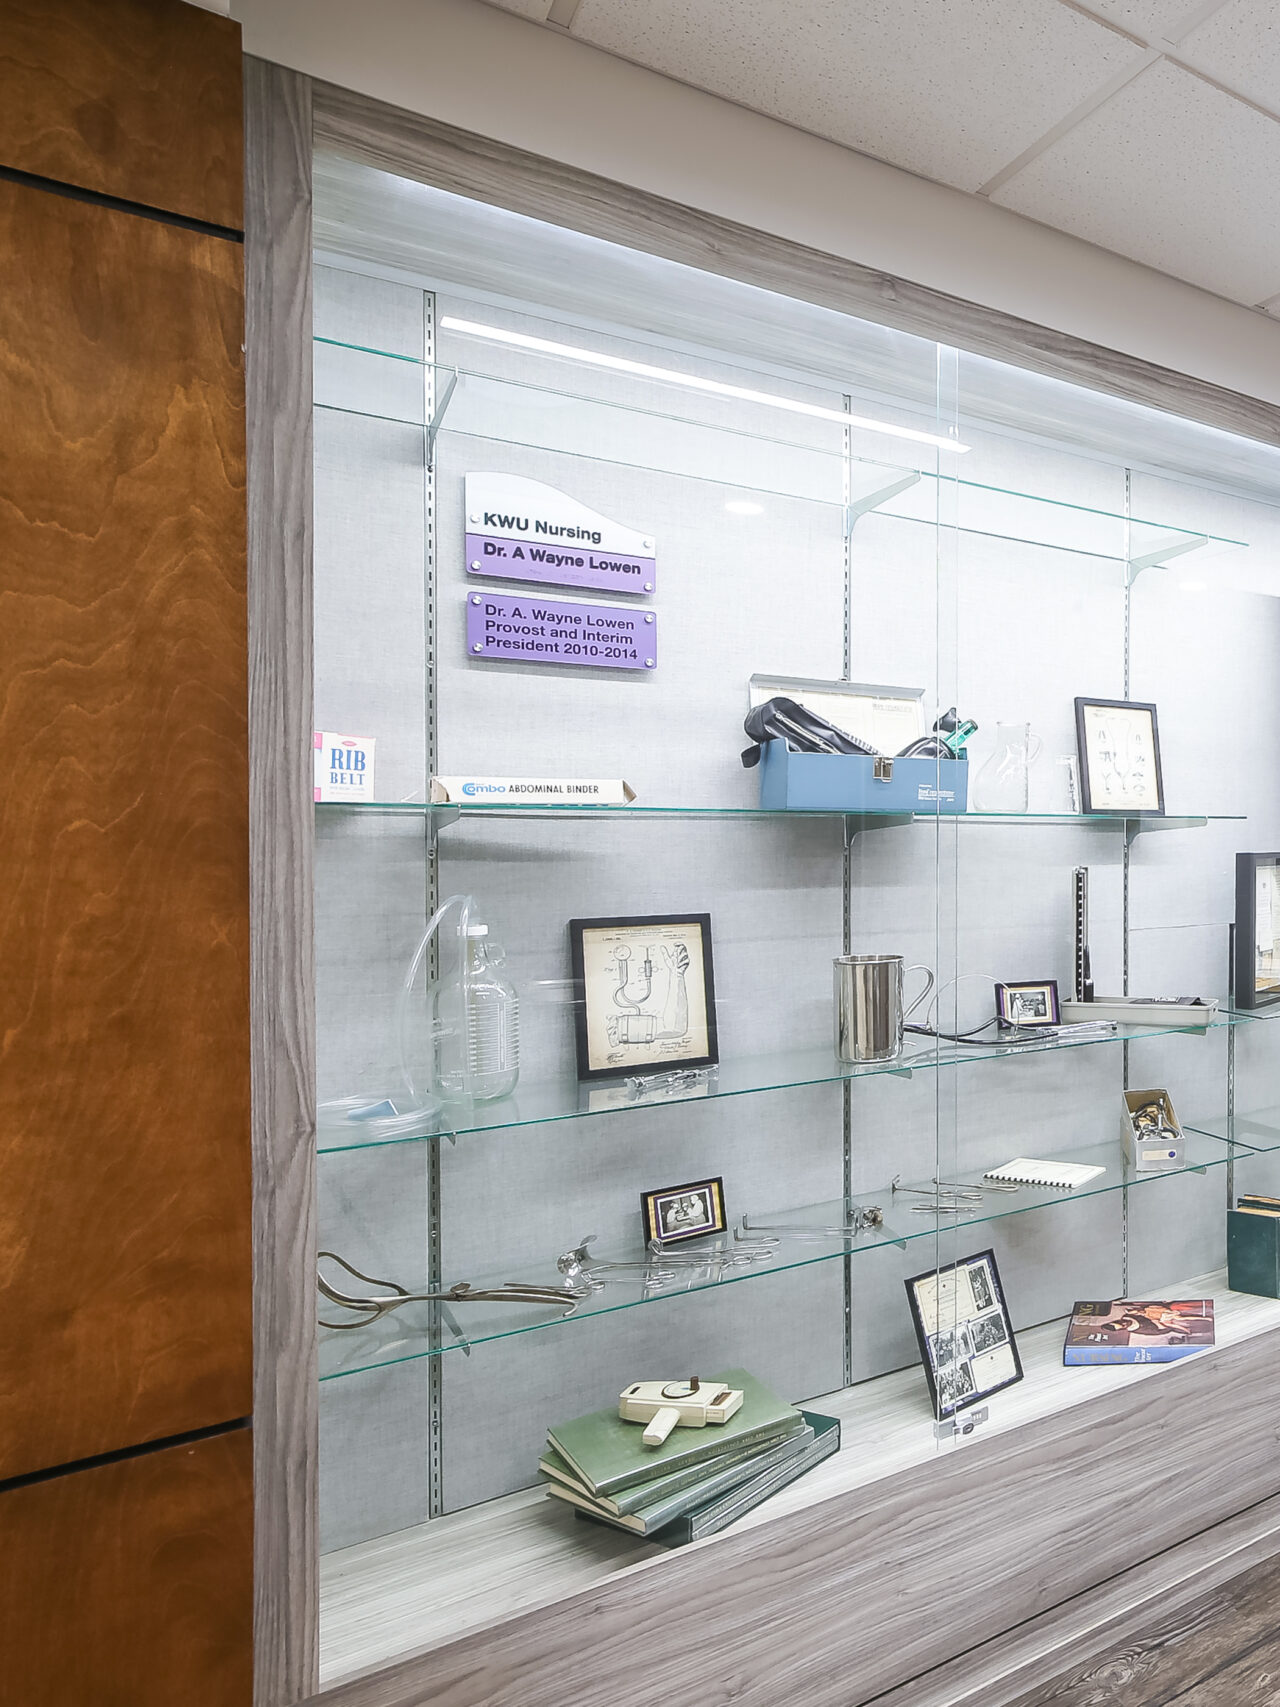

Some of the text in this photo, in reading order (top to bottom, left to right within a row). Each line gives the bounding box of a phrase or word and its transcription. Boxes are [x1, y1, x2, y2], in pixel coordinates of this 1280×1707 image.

[484, 512, 602, 544] KWU Nursing
[483, 542, 642, 575] Dr. A Wayne Lowen
[485, 604, 635, 630] Dr. A. Wayne Lowen
[485, 620, 633, 645] Provost and Interim
[485, 636, 638, 660] President 2010-2014
[330, 748, 366, 771] RIB
[329, 771, 366, 785] BELT
[508, 784, 564, 794] ABDOMINAL
[566, 784, 600, 794] BINDER
